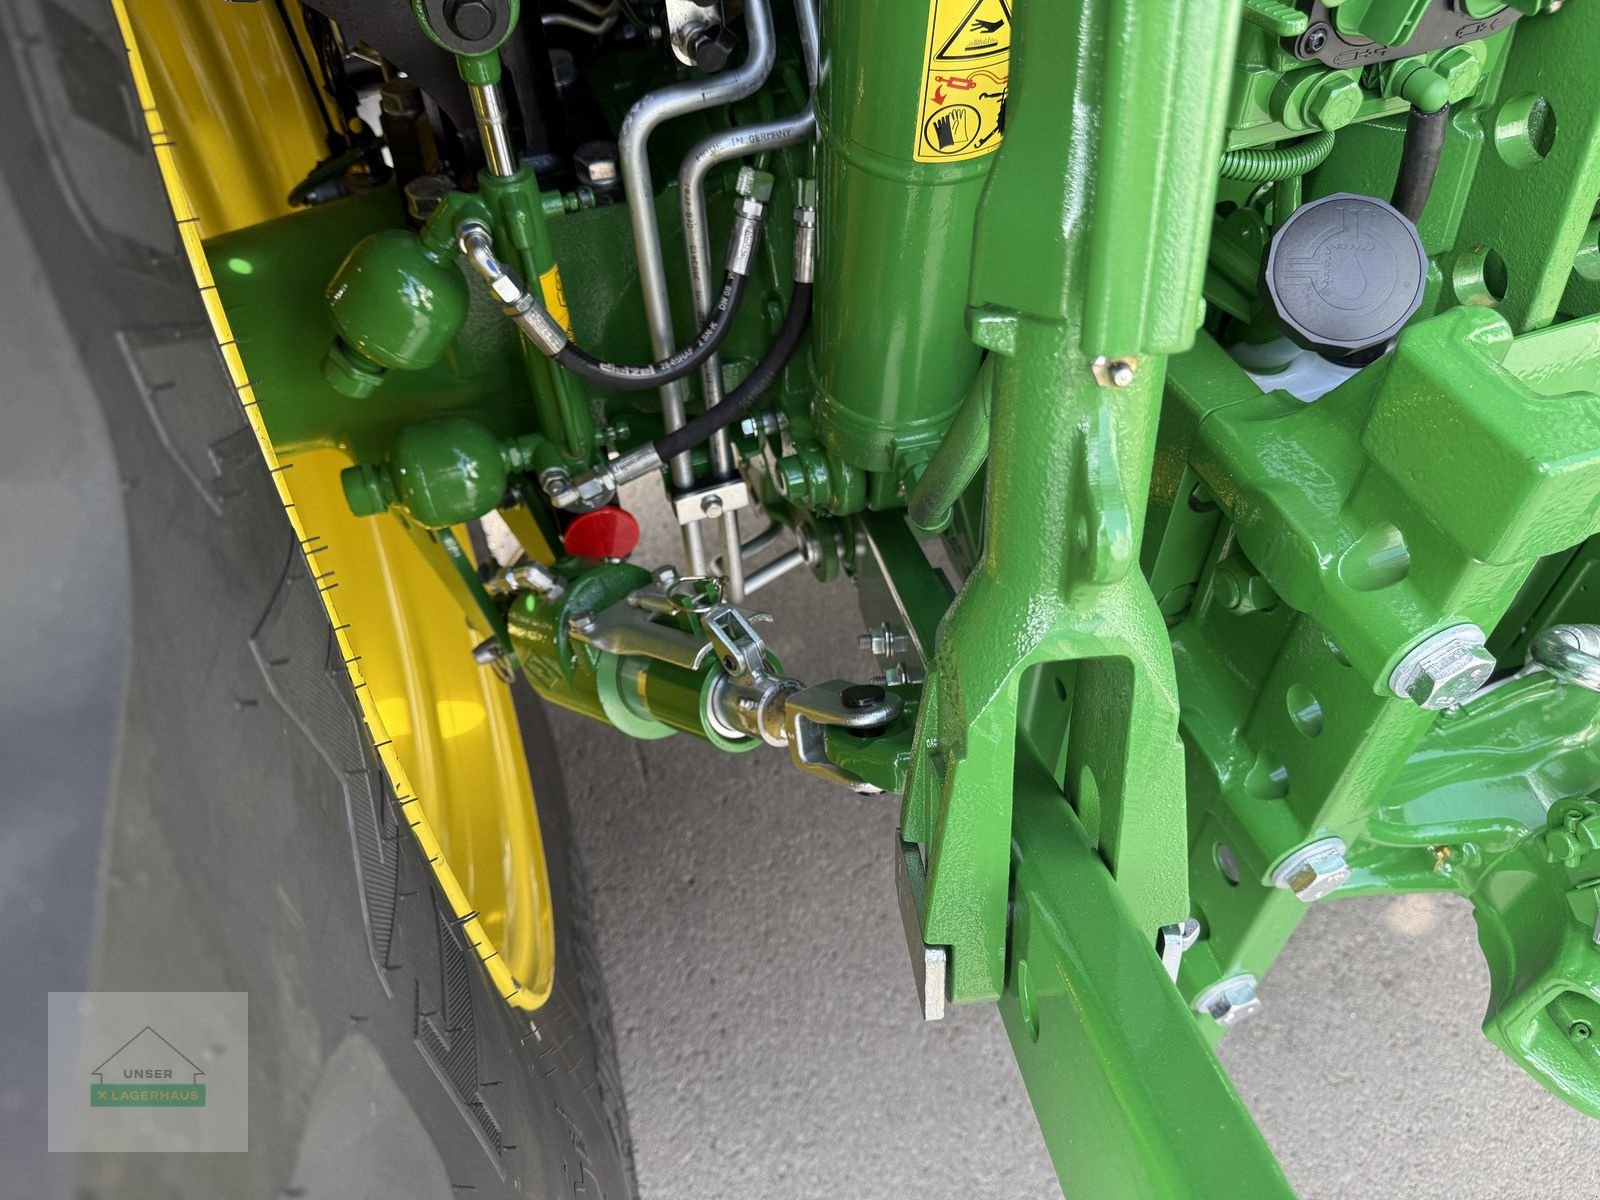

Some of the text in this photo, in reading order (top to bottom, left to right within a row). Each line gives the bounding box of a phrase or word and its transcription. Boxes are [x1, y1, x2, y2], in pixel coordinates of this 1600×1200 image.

[731, 136, 744, 146] IN
[748, 127, 793, 145] GERMANY
[718, 296, 730, 312] DN
